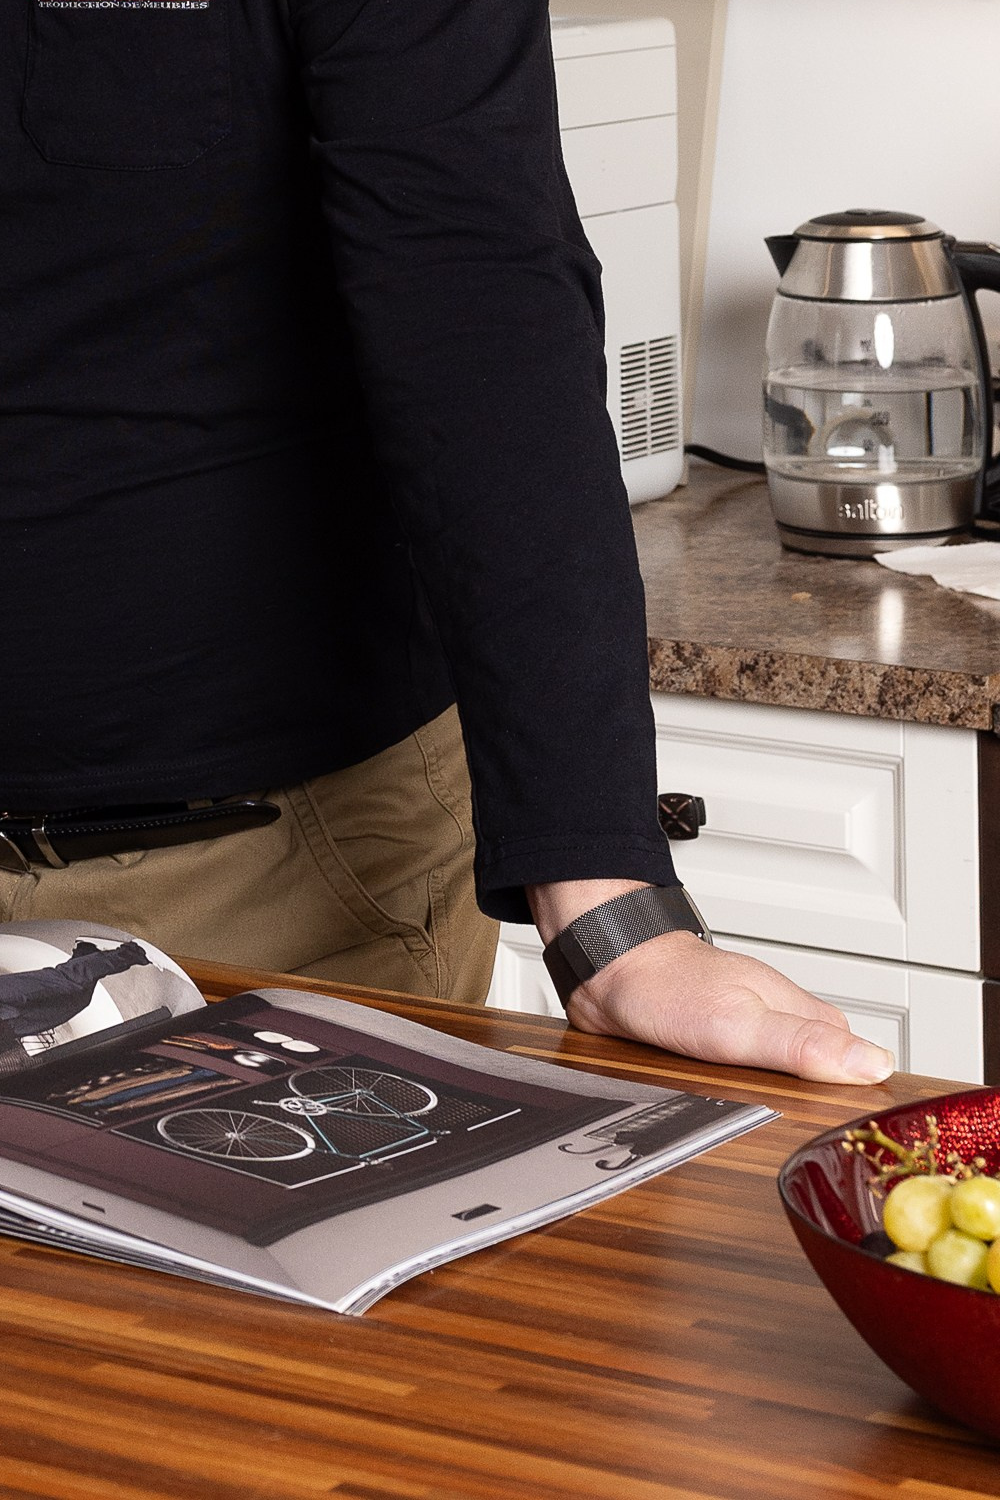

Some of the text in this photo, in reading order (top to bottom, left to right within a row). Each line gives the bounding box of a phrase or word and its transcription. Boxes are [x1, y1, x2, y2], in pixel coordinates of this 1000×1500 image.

[38, 0, 209, 10] PRODUCTION DE MEUBLES
